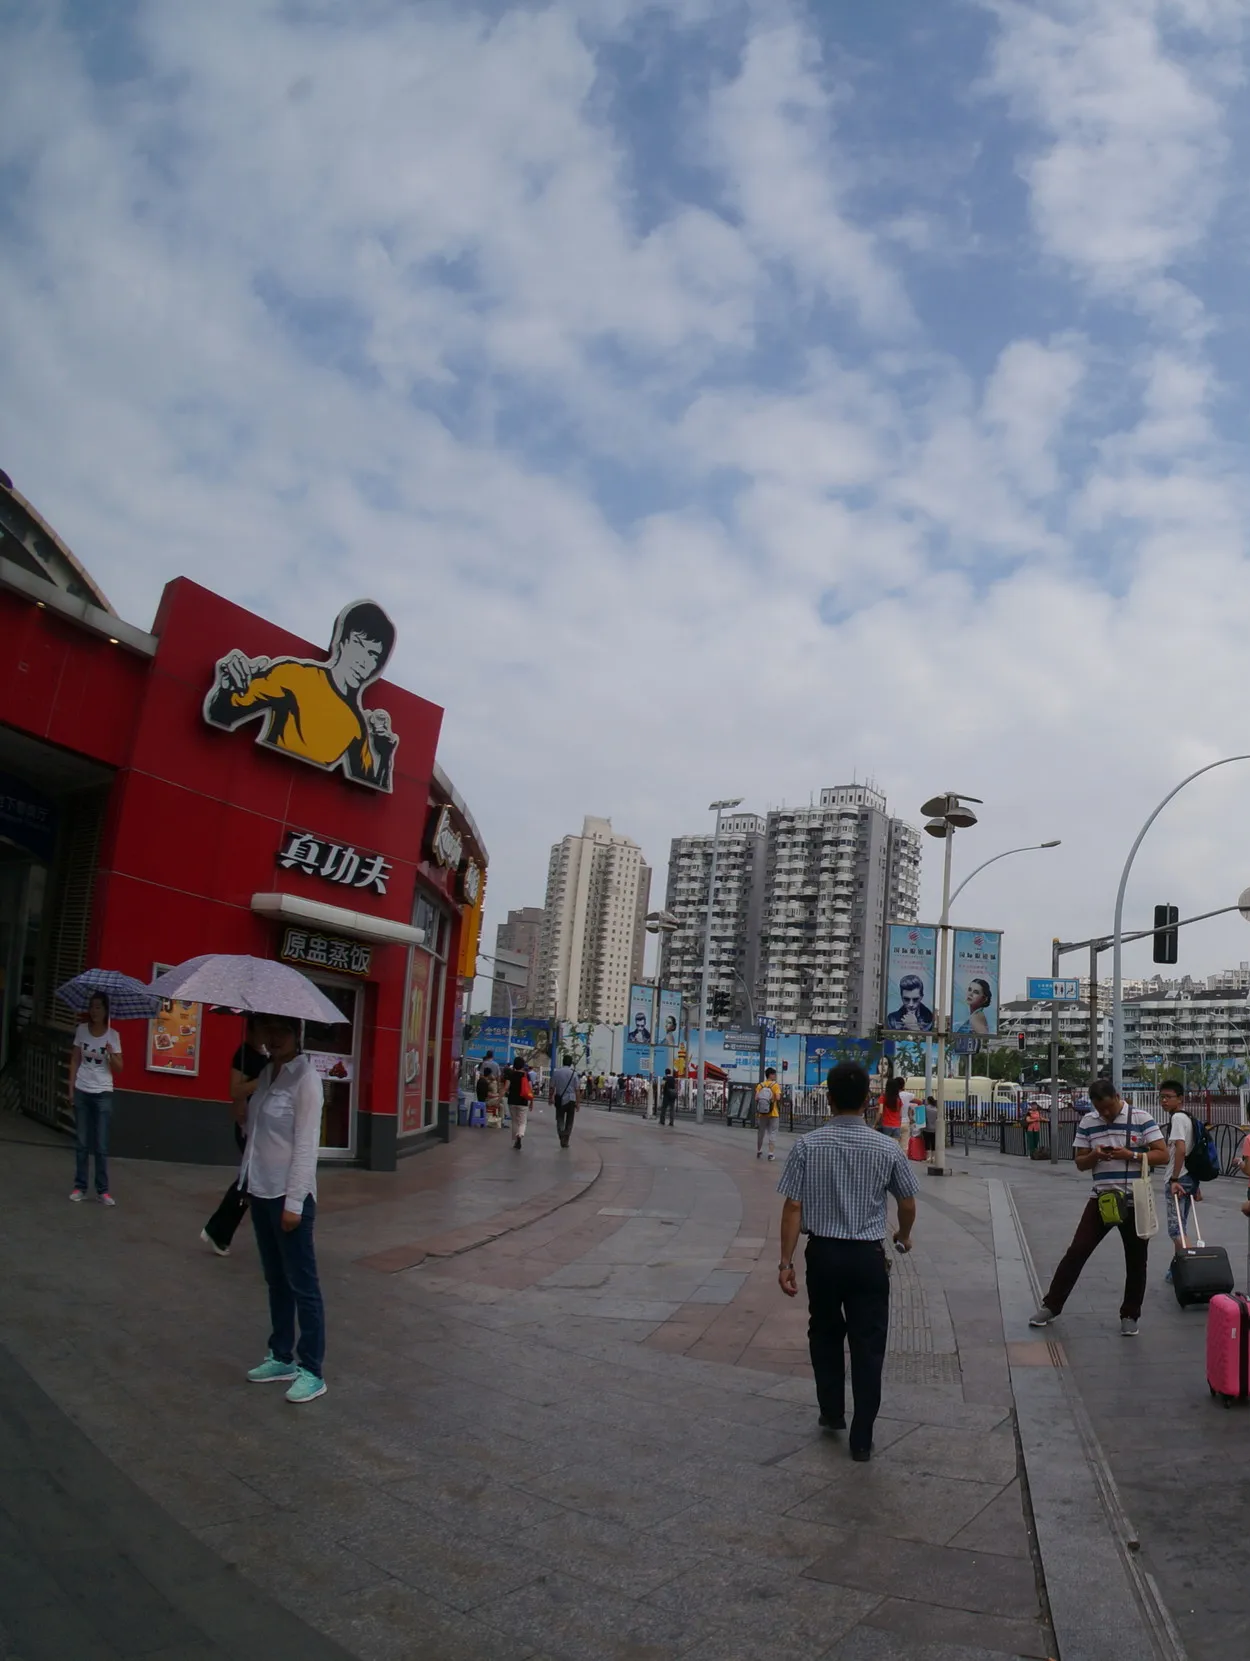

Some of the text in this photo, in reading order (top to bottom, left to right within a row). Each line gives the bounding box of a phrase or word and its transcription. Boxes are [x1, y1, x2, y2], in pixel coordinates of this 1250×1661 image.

[279, 831, 393, 895] 真功夫
[283, 930, 372, 974] 原盅蒸饭
